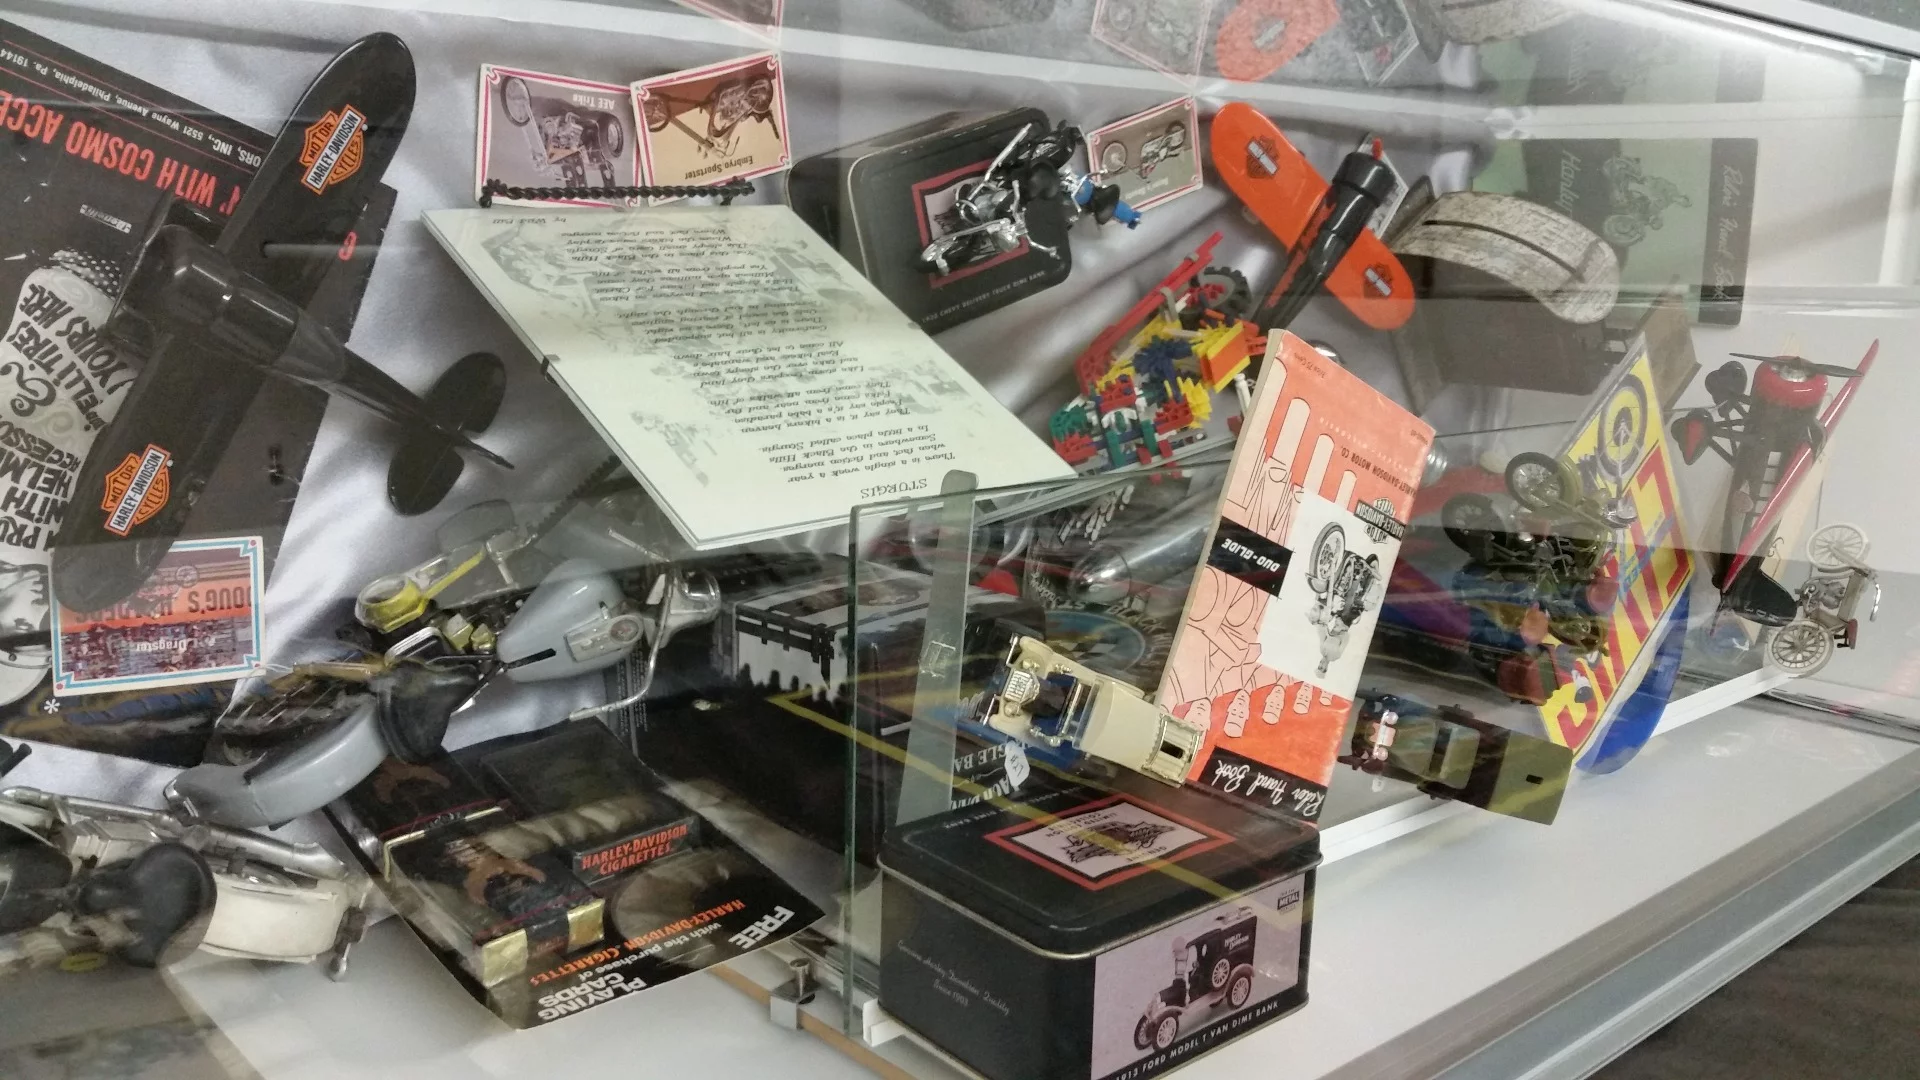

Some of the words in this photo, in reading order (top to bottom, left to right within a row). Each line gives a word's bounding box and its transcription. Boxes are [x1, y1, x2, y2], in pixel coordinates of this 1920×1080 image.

[32, 60, 48, 75] Pa.
[51, 67, 112, 102] Philadelphia,
[114, 96, 149, 117] Avenue,
[571, 93, 594, 106] Trike
[595, 97, 615, 110] AEE
[150, 110, 180, 131] Wayne
[182, 125, 204, 141] 5521
[309, 121, 334, 159] MOTOR
[65, 121, 154, 181] COSMO
[206, 134, 233, 155] INC.,
[310, 113, 358, 185] HARLEY-DAVIDSON
[334, 138, 359, 178] CYCLES
[723, 154, 754, 171] Embryo
[683, 163, 722, 182] Sportster
[153, 157, 218, 208] WITH
[492, 216, 513, 225] Bill
[518, 215, 545, 224] Wild
[1716, 217, 1738, 258] Hand
[938, 304, 960, 316] CHEVY
[961, 292, 991, 307] DELIVERY
[991, 283, 1011, 295] TRUCK
[1011, 277, 1029, 287] DIME
[1028, 269, 1046, 280] BANK
[19, 283, 73, 328] HERE
[805, 387, 830, 395] from
[865, 380, 890, 389] They
[748, 393, 783, 401] walks
[804, 397, 829, 405] from
[864, 390, 890, 399] Folks
[870, 399, 901, 408] People
[885, 407, 909, 417] They
[787, 409, 811, 418] babe
[740, 424, 781, 433] heaven
[786, 418, 820, 428] bikers
[809, 436, 841, 447] called
[845, 431, 873, 441] place
[877, 428, 902, 438] little
[877, 433, 935, 448] Somewhere
[802, 448, 834, 459] Black
[839, 445, 857, 453] the
[869, 451, 889, 460] and
[918, 442, 945, 452] when
[768, 453, 796, 464] Hills
[829, 455, 864, 466] fiction
[864, 460, 896, 471] single
[924, 452, 955, 463] There
[1351, 454, 1370, 470] MOTOR
[0, 452, 72, 498] HELM
[787, 472, 814, 482] year
[832, 466, 859, 476] week
[111, 465, 136, 502] MOTOR
[112, 452, 162, 531] HARLEY-DAVIDSON
[859, 477, 927, 498] STURGIS
[139, 476, 165, 519] CYCLES
[1366, 525, 1388, 542] MOTOR
[1221, 536, 1280, 572] DUO-GLIDE
[135, 638, 186, 654] Dragster
[1214, 757, 1250, 793] Book
[1249, 768, 1287, 807] Hand
[1290, 784, 1324, 819] Rider
[582, 824, 688, 869] HARLEY-DAVIDSON
[600, 842, 673, 875] CIGARETTES
[1279, 892, 1299, 909] METAL
[624, 899, 745, 950] HARLEY-DAVIDSON
[689, 922, 721, 939] with
[728, 905, 796, 950] FREE
[663, 933, 688, 950] the
[530, 947, 620, 986] CIGARETTES
[595, 943, 660, 974] purchase
[578, 969, 594, 982] of
[538, 972, 624, 1007] CARDS
[933, 978, 952, 995] Since
[537, 977, 647, 1021] PLAYING
[1139, 1053, 1168, 1072] FORD
[1167, 1036, 1200, 1058] MODEL
[1199, 1032, 1208, 1042] T
[1208, 1022, 1229, 1038] VAN
[1229, 1011, 1254, 1029] DIME
[1253, 999, 1280, 1017] BANK
